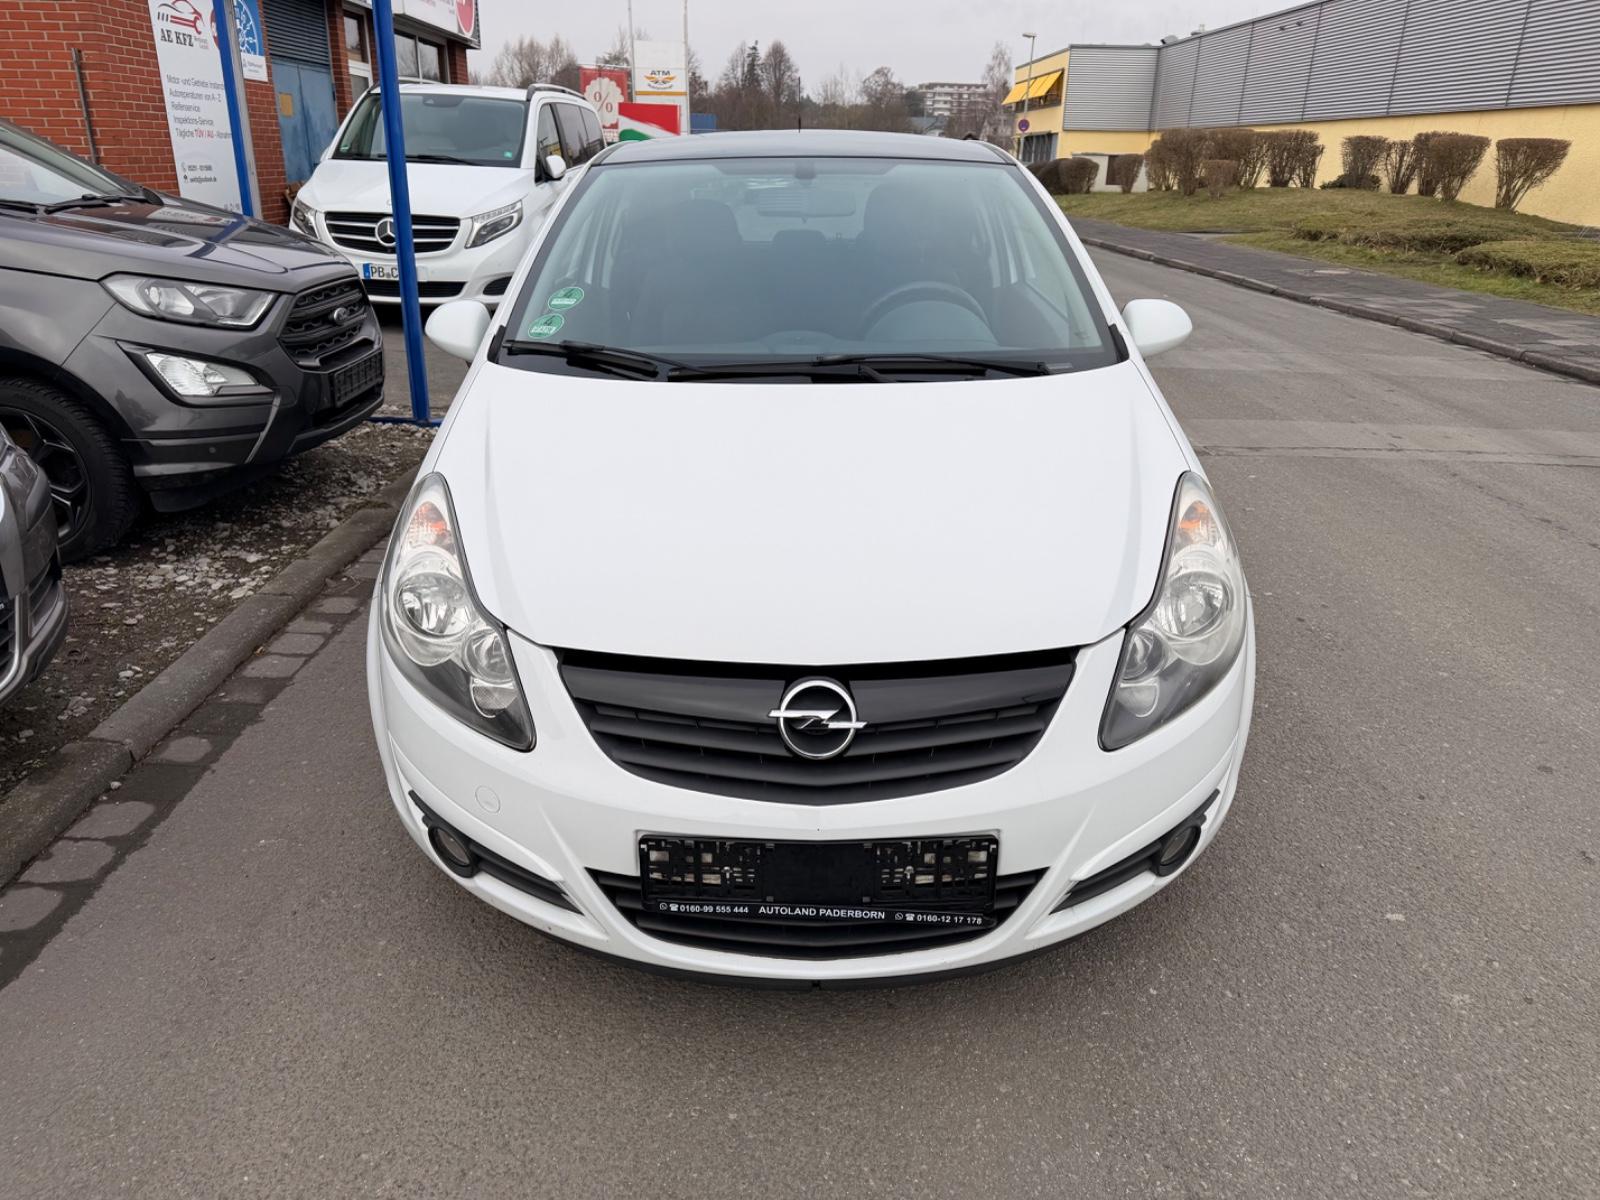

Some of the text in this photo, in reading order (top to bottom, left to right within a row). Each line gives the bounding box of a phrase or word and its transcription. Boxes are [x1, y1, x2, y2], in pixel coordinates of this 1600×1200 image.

[161, 28, 173, 43] AE
[174, 31, 194, 47] KFZ
[371, 266, 385, 278] PB
[680, 905, 713, 913] 0160-99
[715, 905, 731, 913] 555
[758, 905, 816, 916] AUTOLAND
[819, 909, 885, 919] PADERBORN
[917, 914, 951, 923] 0160-12
[954, 915, 963, 923] 17
